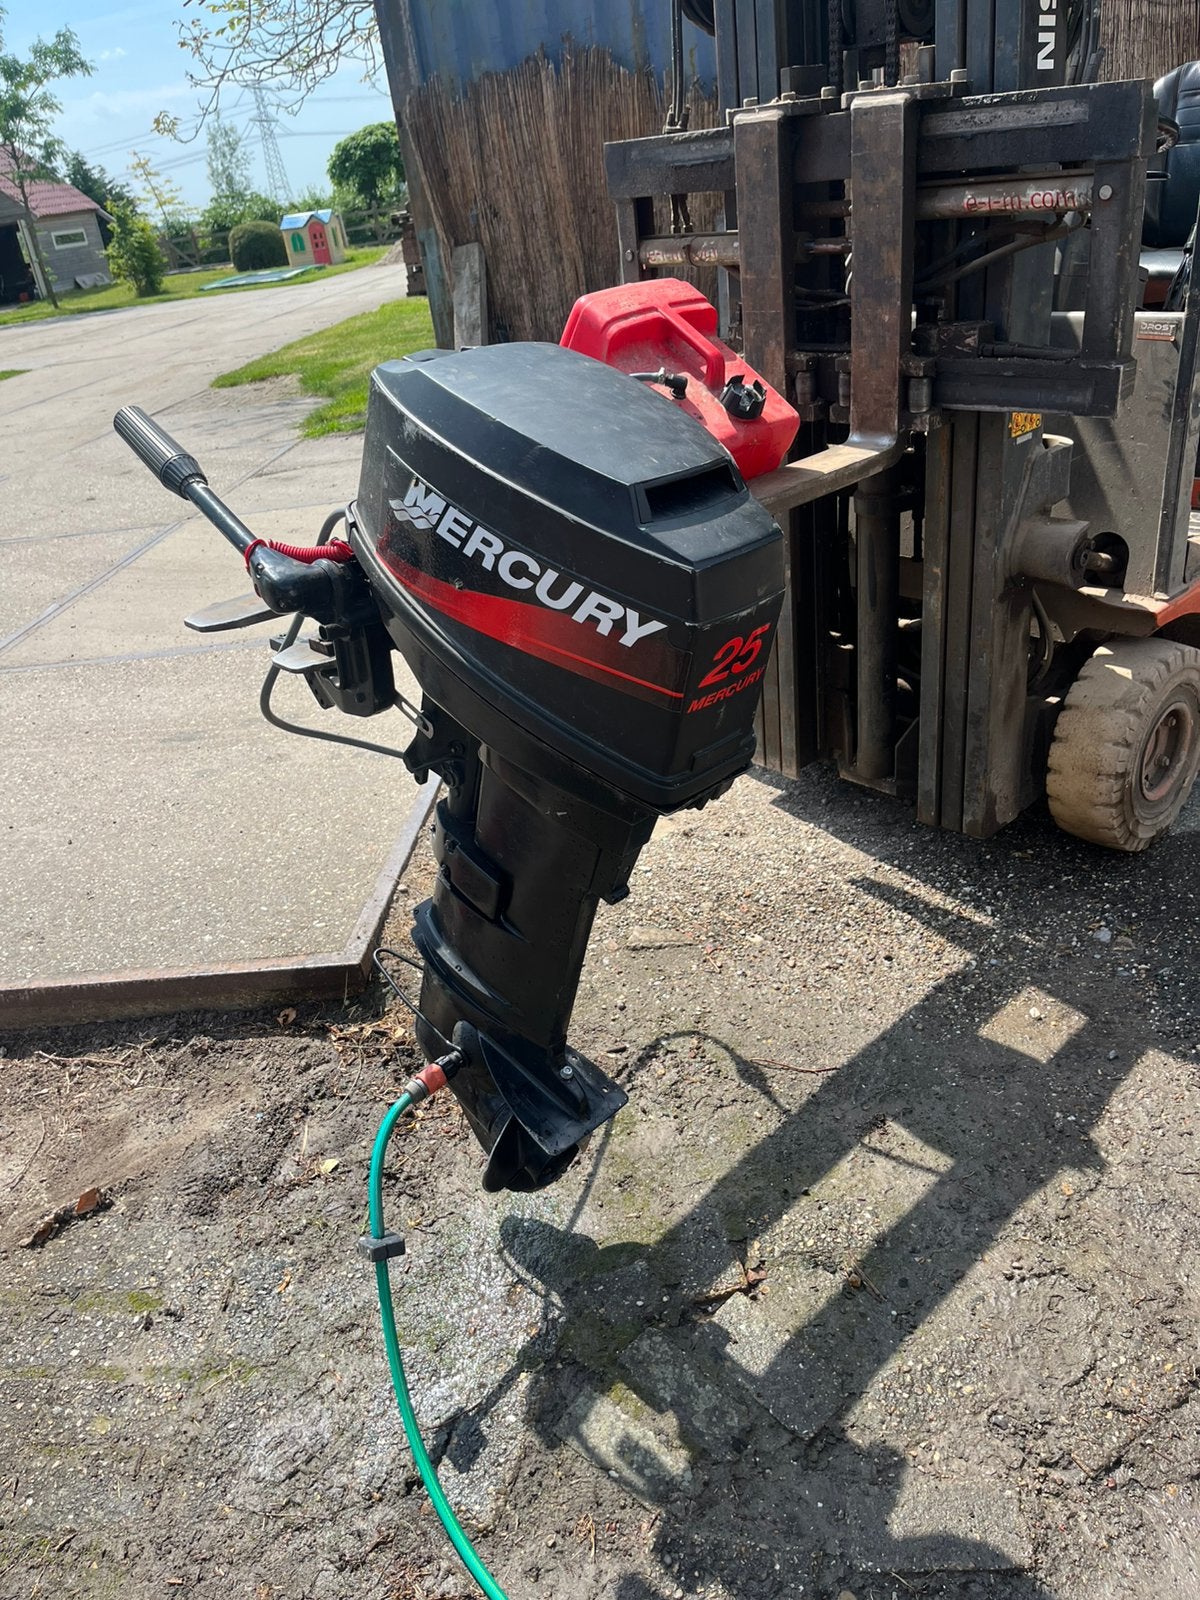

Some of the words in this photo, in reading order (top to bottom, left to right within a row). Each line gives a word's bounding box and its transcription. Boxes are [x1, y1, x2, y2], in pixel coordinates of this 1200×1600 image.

[390, 481, 668, 648] MERCURY
[698, 622, 771, 688] 25
[687, 665, 767, 713] MERCURY
